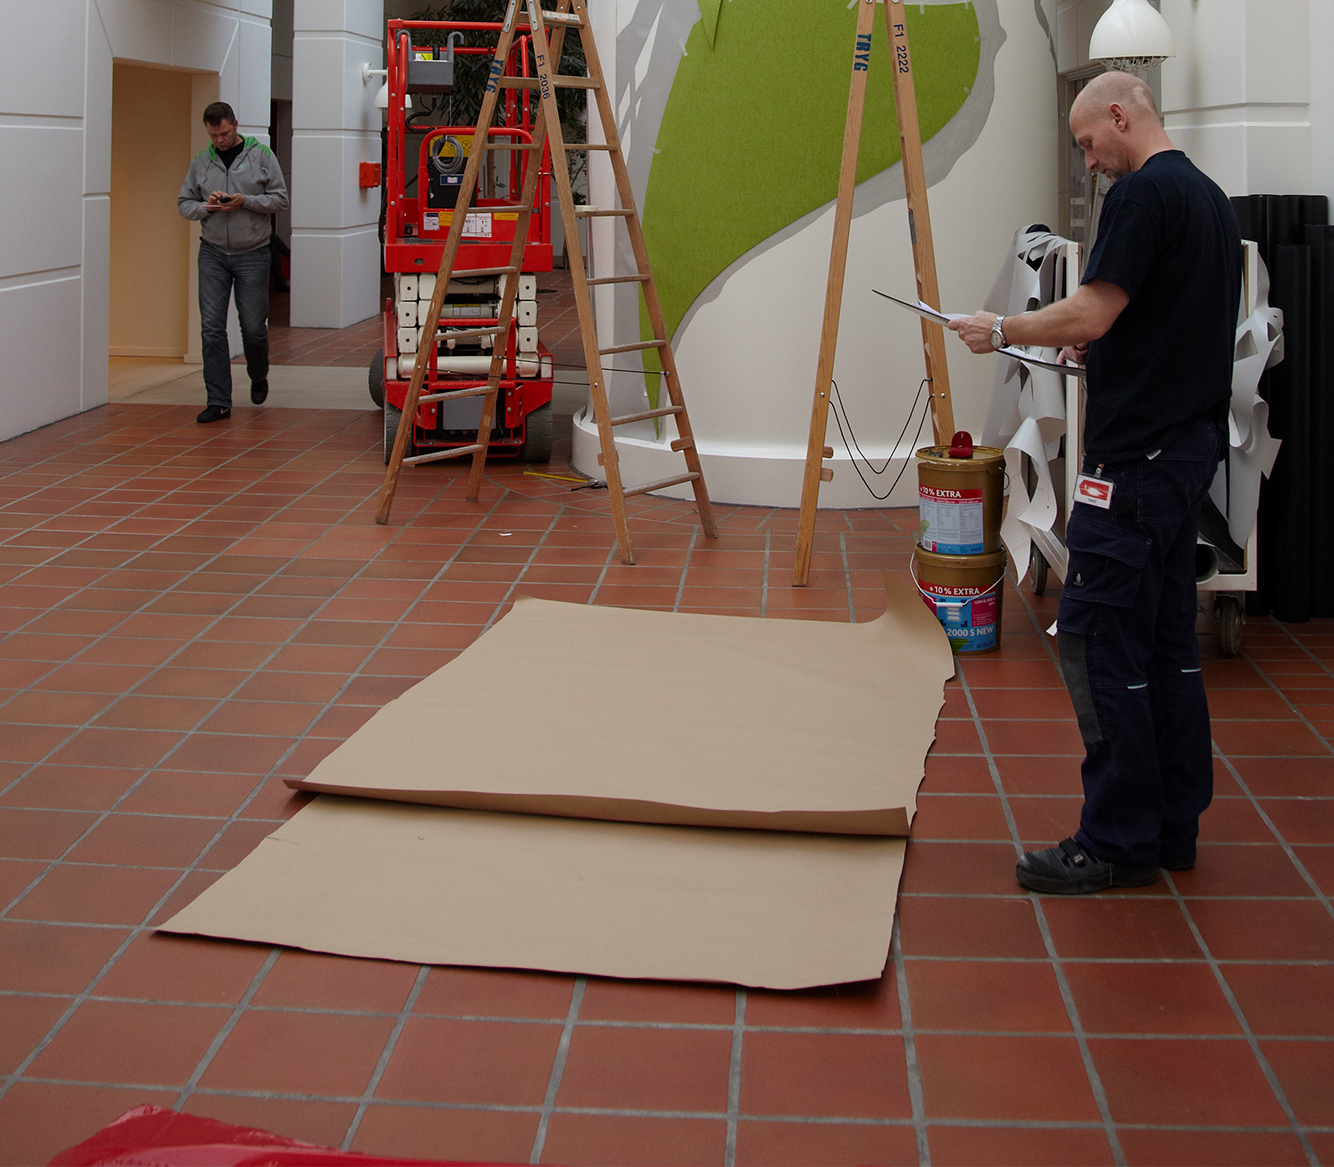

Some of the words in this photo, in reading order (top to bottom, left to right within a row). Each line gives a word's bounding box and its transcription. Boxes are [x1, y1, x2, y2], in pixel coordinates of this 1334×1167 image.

[894, 24, 904, 37] F1
[854, 33, 871, 71] TRYG
[897, 45, 909, 73] 2222
[536, 54, 546, 68] F1
[486, 58, 504, 94] TRYG
[539, 73, 551, 100] 2036
[936, 489, 962, 498] EXTRA
[953, 587, 980, 596] EXTRA
[947, 628, 969, 637] 2000
[969, 629, 975, 637] S
[976, 625, 994, 636] NEW
